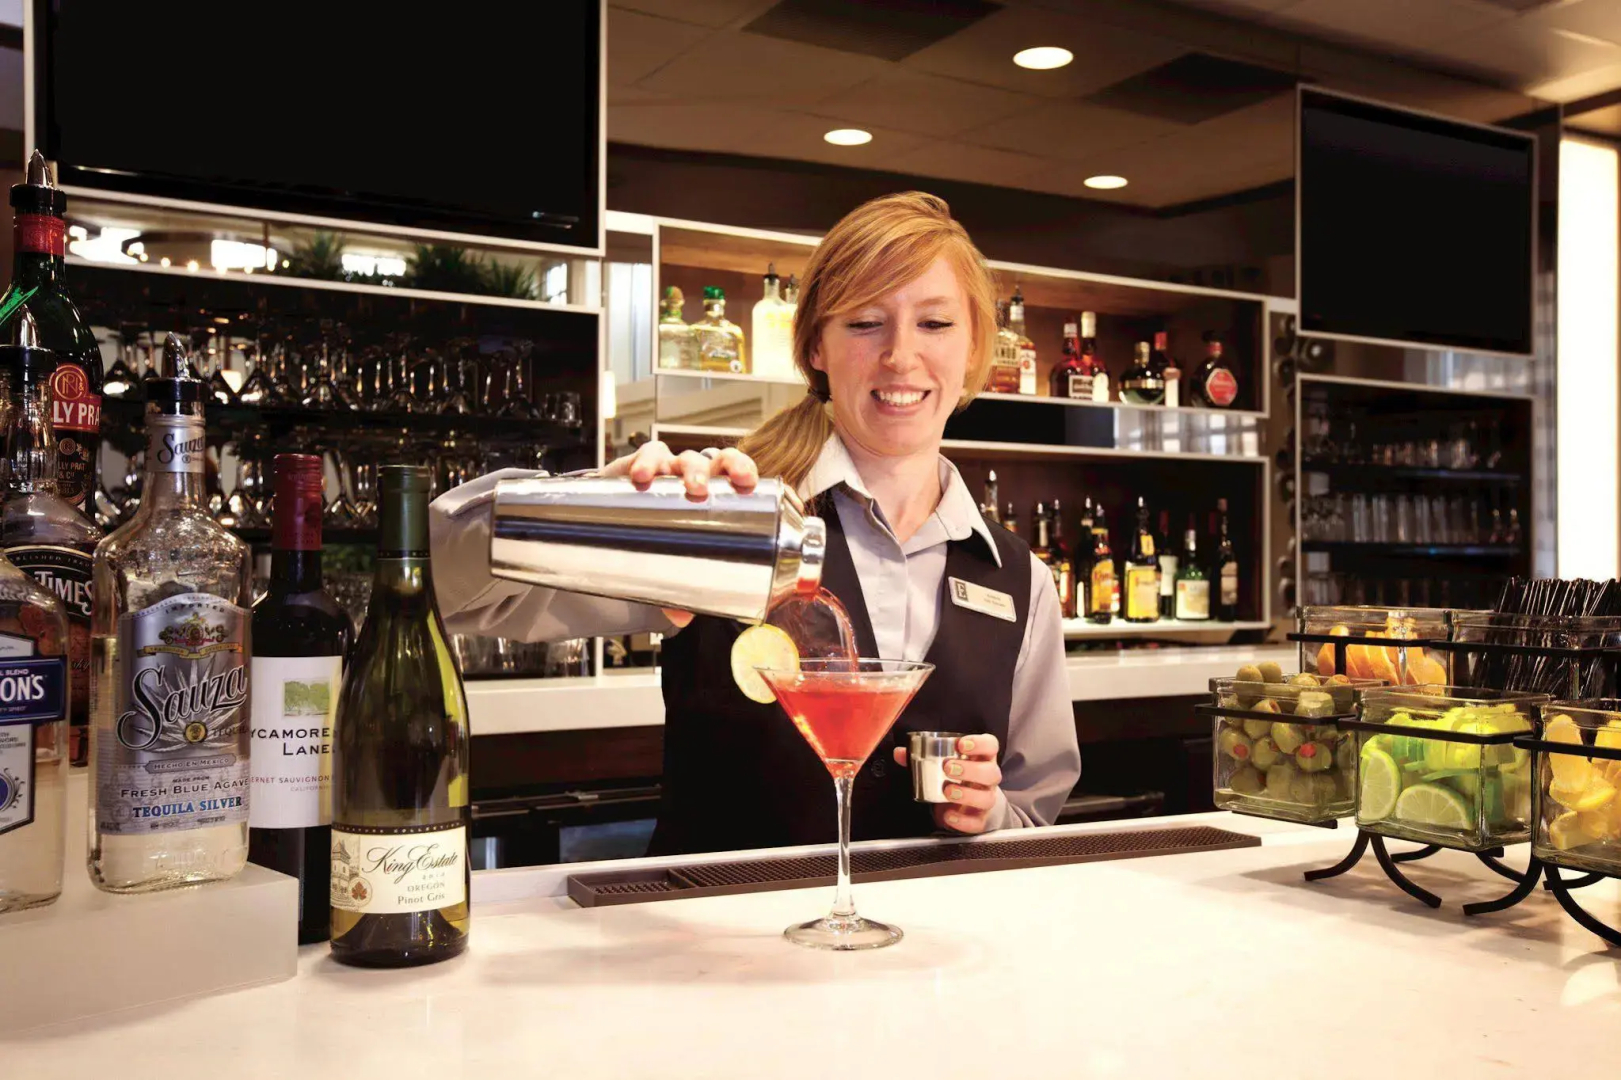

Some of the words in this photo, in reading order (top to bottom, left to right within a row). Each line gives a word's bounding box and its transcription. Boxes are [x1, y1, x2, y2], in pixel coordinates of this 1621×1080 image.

[53, 400, 75, 424] LY
[78, 402, 100, 426] PRA
[165, 603, 225, 615] IMPORTED
[5, 668, 30, 676] BLEND
[0, 674, 45, 702] ON'S
[116, 665, 248, 750] Sauza
[250, 727, 331, 739] YCAMORE
[282, 742, 331, 756] LANE
[200, 758, 230, 767] MEXICO
[250, 777, 275, 785] ERNET
[279, 774, 331, 785] SAUVIGNON
[120, 788, 168, 799] FRESH
[173, 783, 209, 795] BLUE
[213, 777, 250, 790] AGAVE
[132, 802, 195, 819] TEQUILA
[199, 796, 243, 812] SILVER
[407, 843, 459, 870] Estate
[406, 881, 446, 893] OREGON
[397, 894, 424, 905] Pinot
[426, 892, 446, 903] Gris
